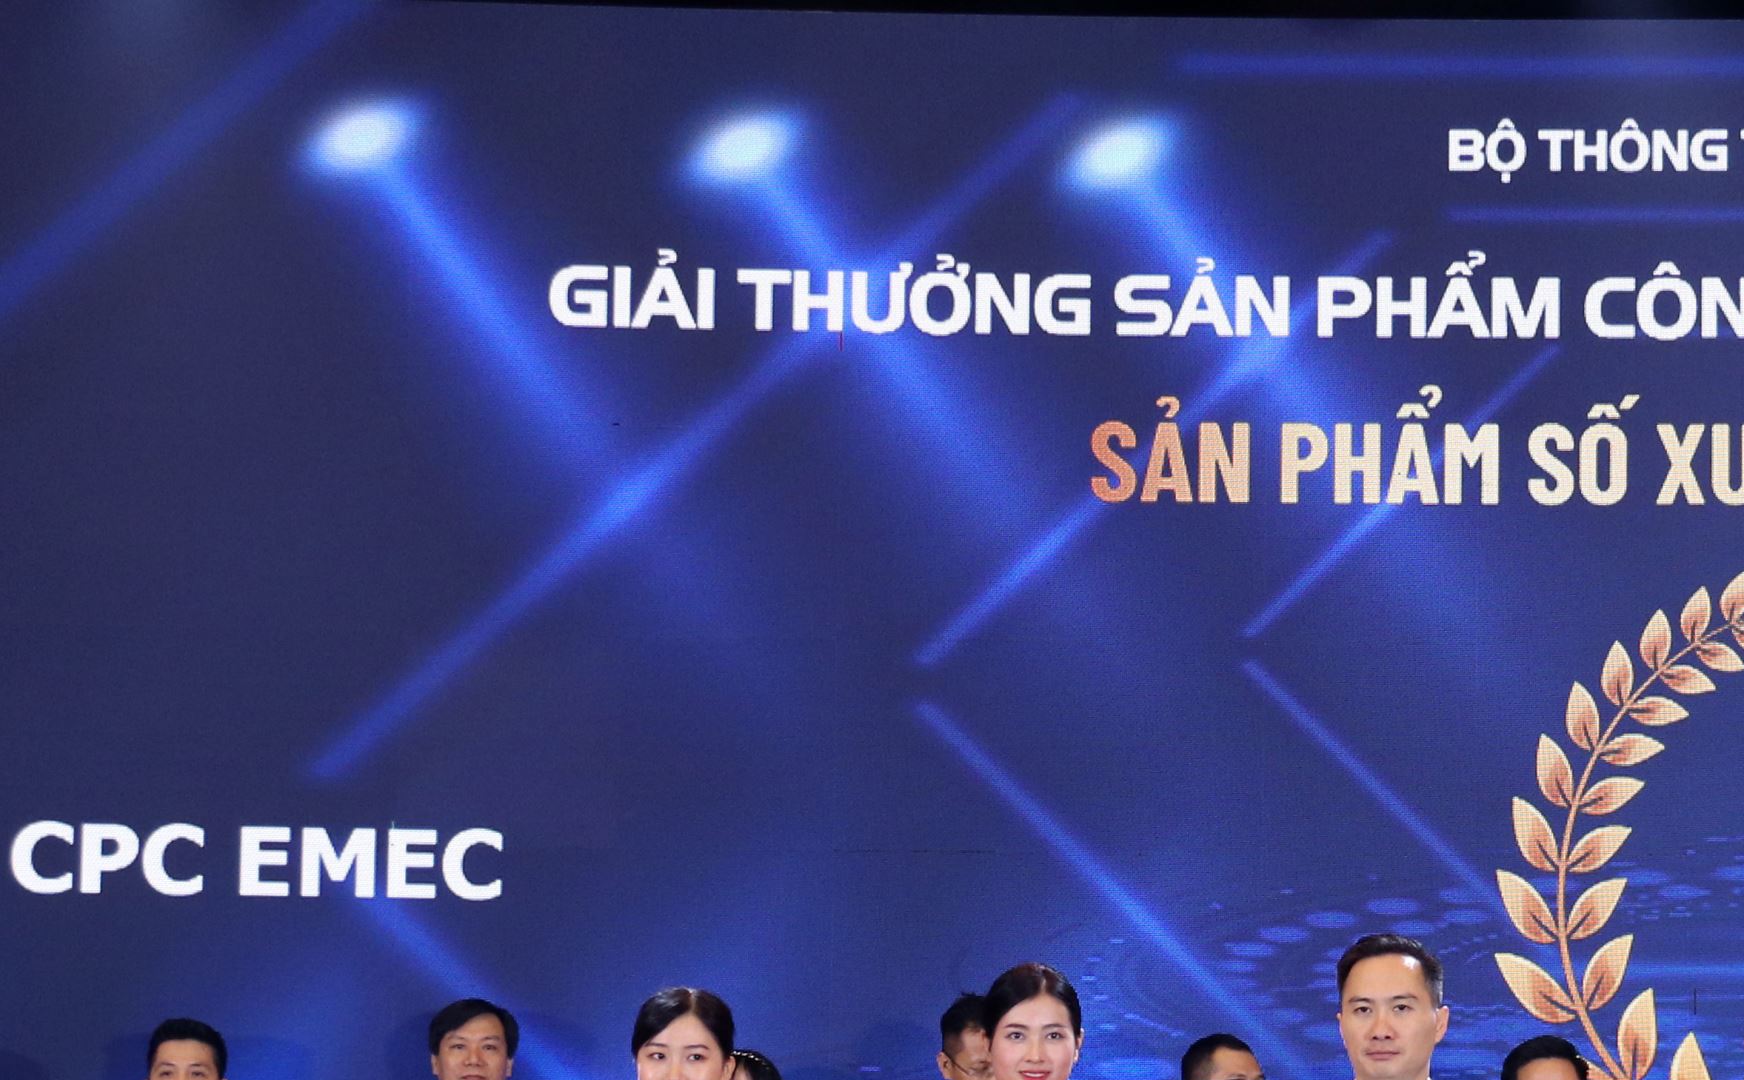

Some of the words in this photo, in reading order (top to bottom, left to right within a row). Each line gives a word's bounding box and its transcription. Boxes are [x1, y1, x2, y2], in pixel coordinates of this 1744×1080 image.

[1450, 119, 1527, 186] BỘ
[1538, 119, 1728, 173] THÔNG
[549, 249, 716, 331] GIẢI
[737, 254, 1093, 338] THƯỞNG
[1115, 257, 1291, 339] SẢN
[1318, 251, 1562, 340] PHẨM
[1091, 397, 1251, 504] SẢN
[1281, 385, 1501, 507] PHẨM
[1528, 395, 1641, 507] SỐ
[11, 821, 206, 898] CPC
[239, 827, 504, 902] EMEC
